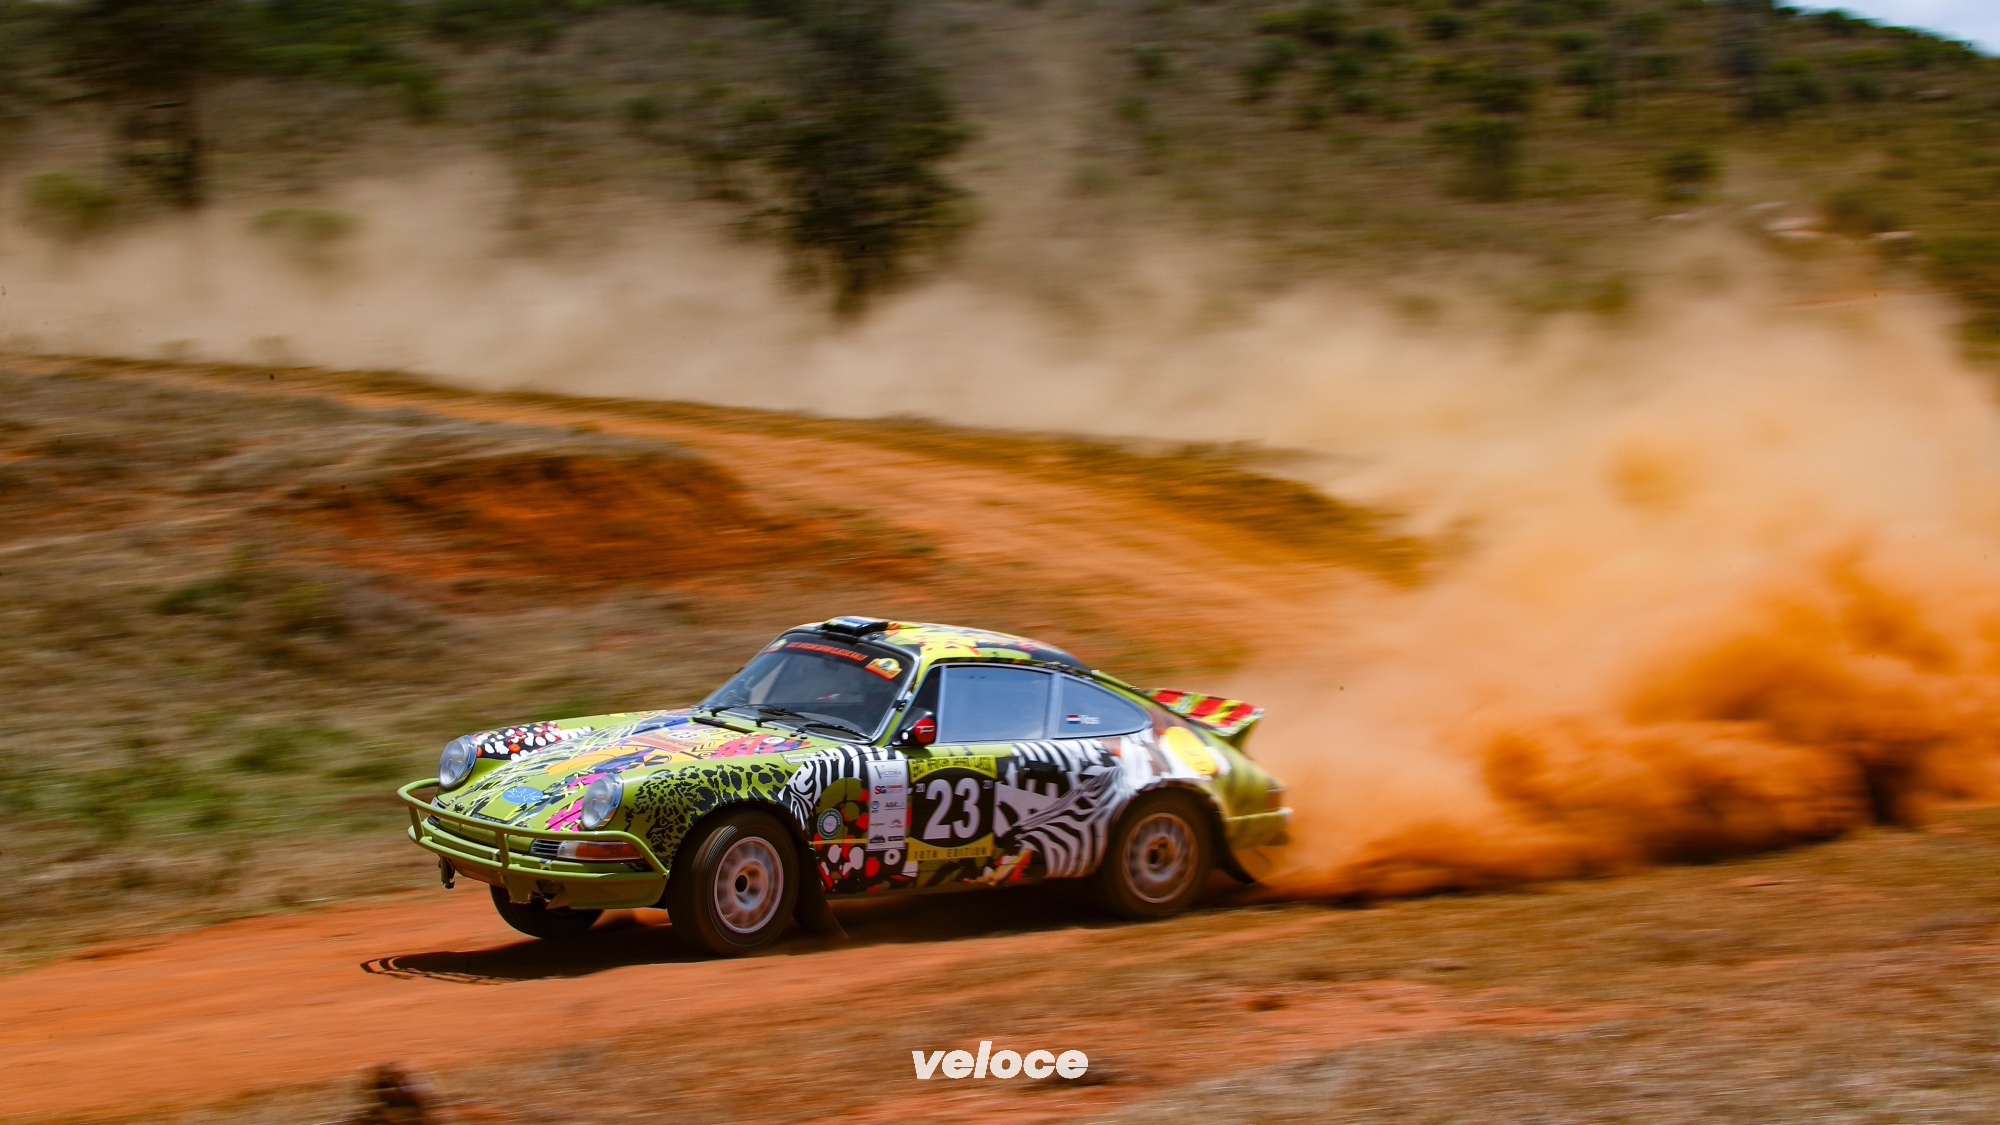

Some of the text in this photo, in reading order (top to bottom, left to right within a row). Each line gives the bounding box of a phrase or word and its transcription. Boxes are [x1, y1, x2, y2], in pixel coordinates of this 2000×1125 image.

[923, 777, 981, 840] 23
[914, 846, 987, 860] 10TH EDITION
